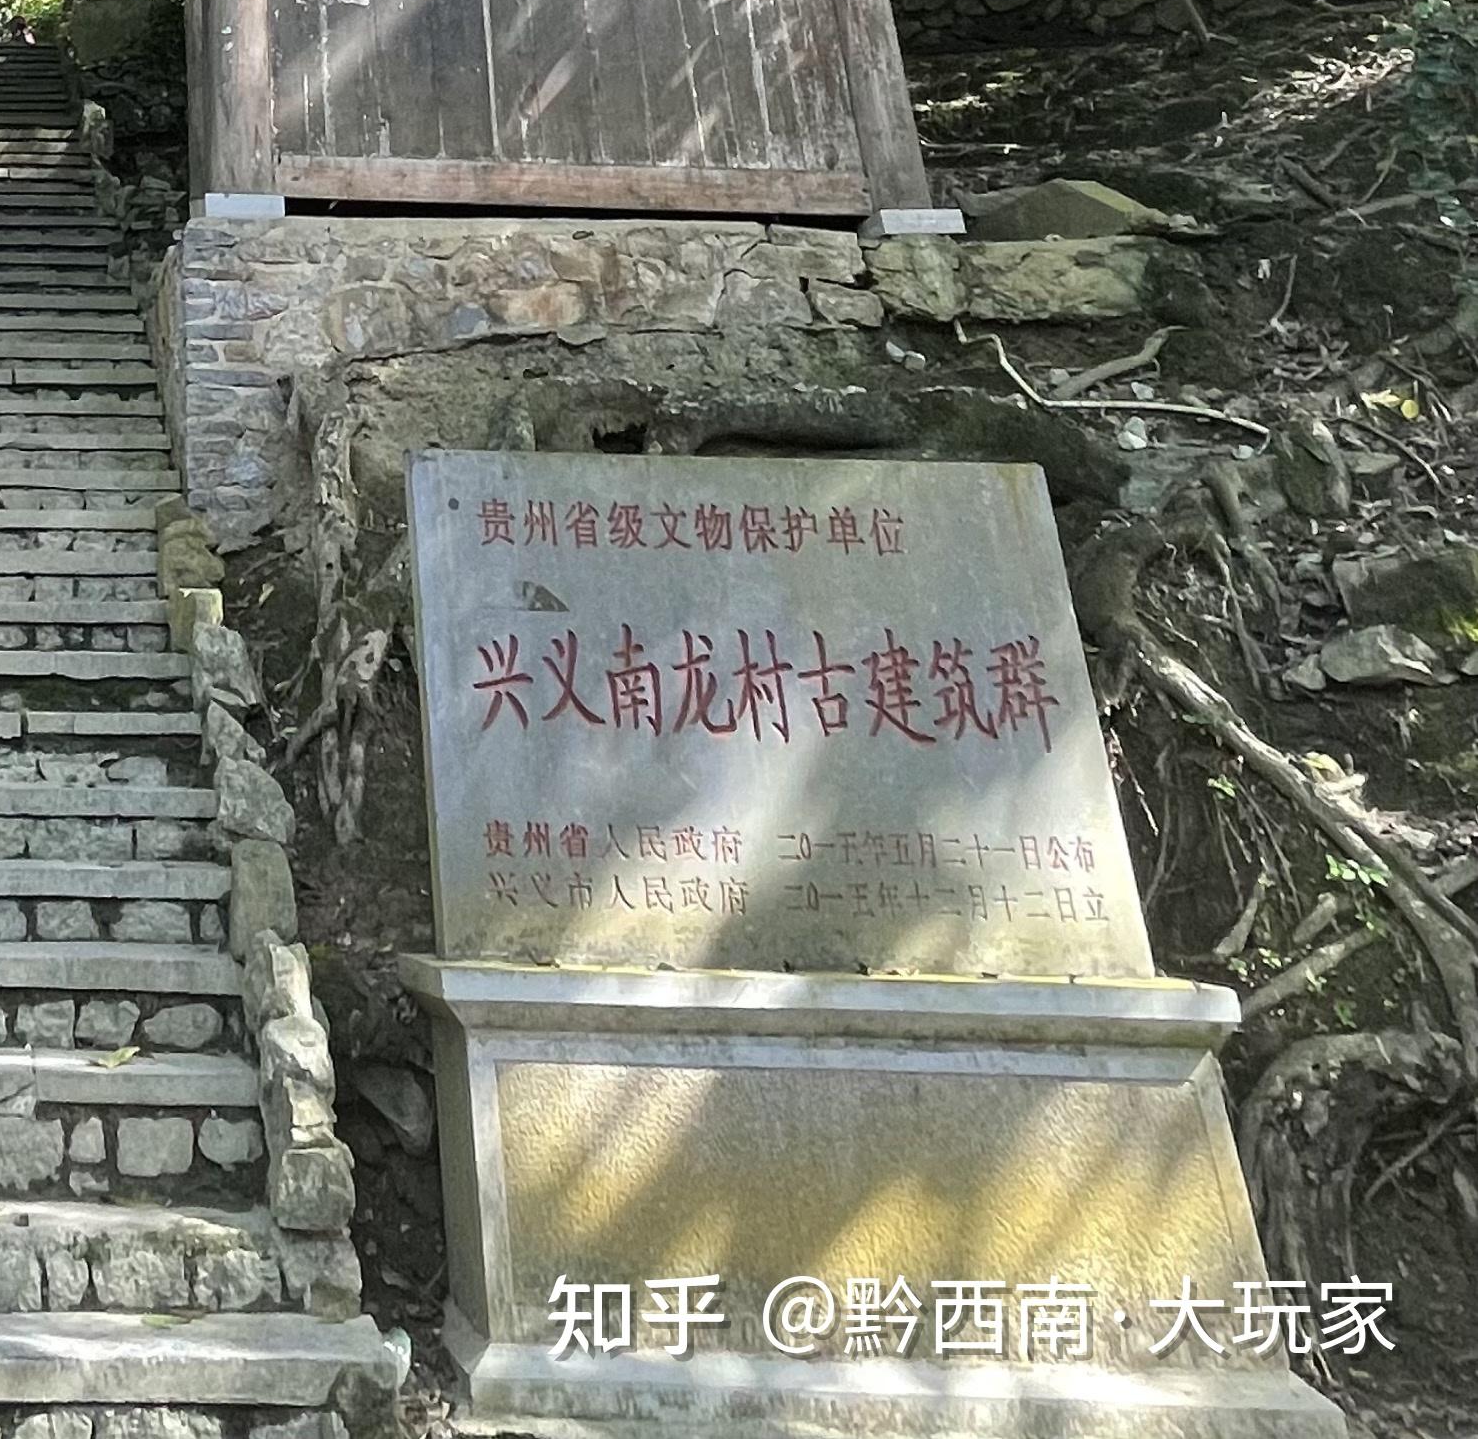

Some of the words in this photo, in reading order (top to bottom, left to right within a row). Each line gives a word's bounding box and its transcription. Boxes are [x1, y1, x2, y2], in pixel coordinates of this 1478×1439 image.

[476, 498, 905, 555] 贵州省级文物保护单位
[473, 623, 1060, 753] 兴义南龙村古建筑群
[483, 819, 743, 864] 贵州省人民政府
[488, 872, 749, 916] 兴义市人民政府
